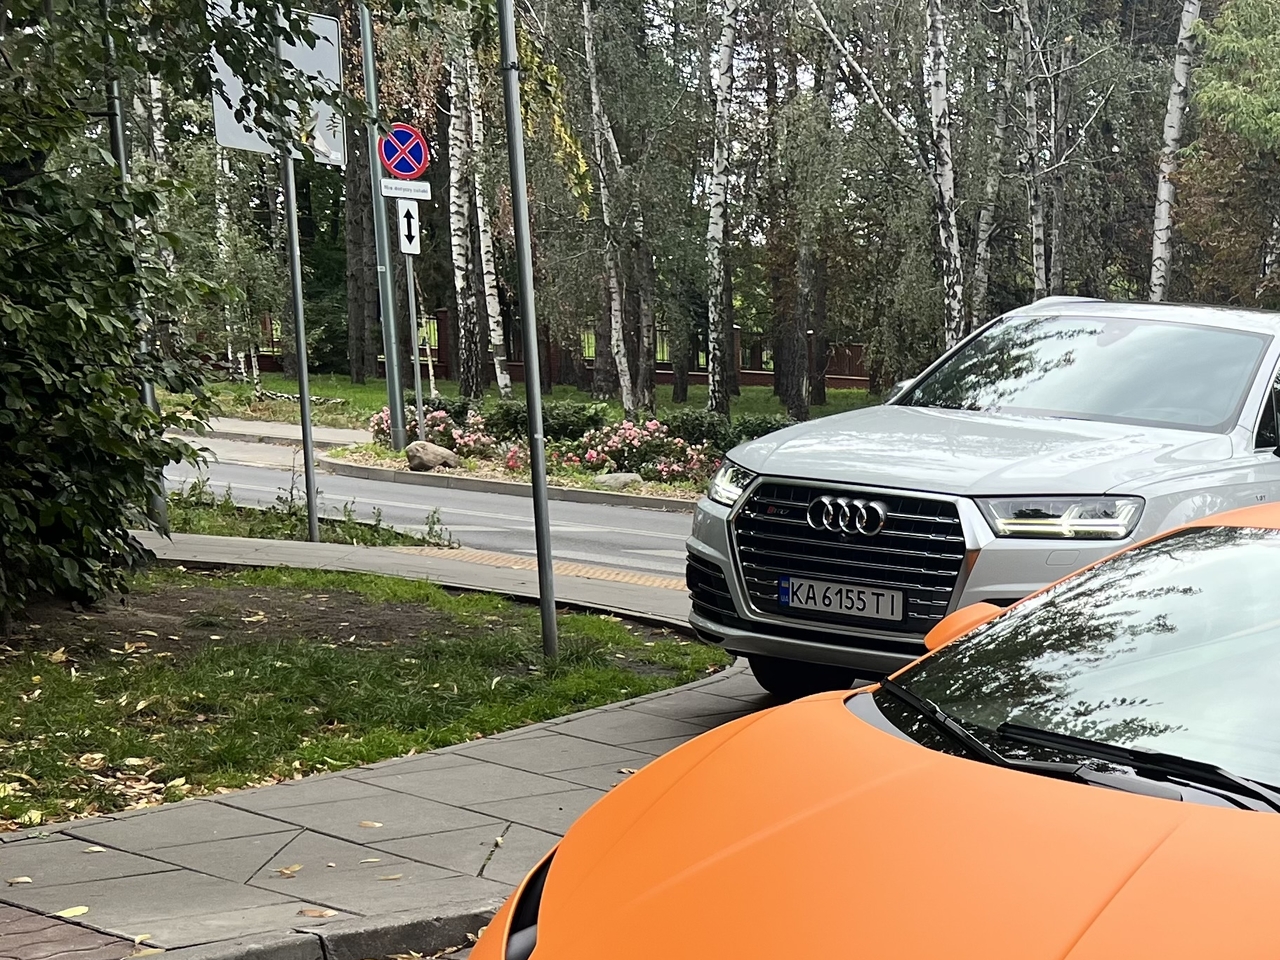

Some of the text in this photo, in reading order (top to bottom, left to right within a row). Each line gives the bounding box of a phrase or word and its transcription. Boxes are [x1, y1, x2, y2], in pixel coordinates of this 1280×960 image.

[791, 581, 896, 617] KA 6155 TI
